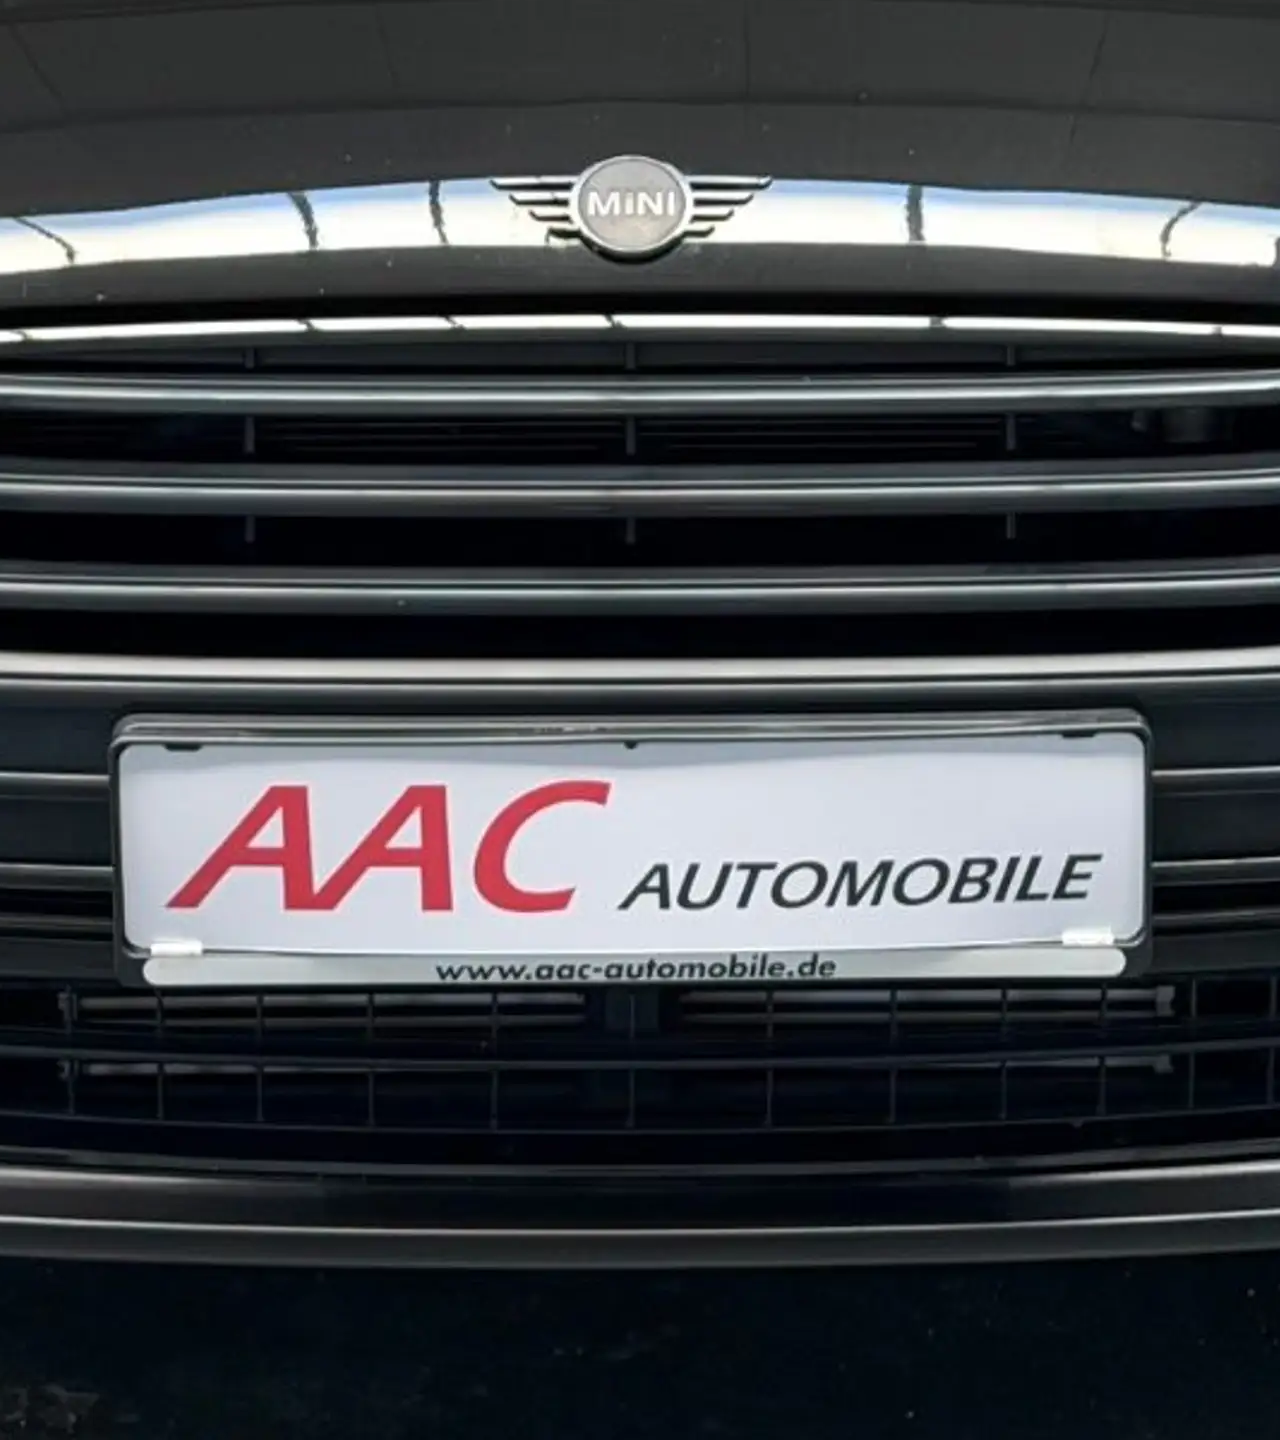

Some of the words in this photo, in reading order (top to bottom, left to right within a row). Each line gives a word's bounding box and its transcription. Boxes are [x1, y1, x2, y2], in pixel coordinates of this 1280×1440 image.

[587, 191, 676, 217] MINI
[166, 780, 611, 913] AAC
[618, 853, 1103, 911] AUTOMOBILE
[435, 953, 837, 982] www.aac-automobile.de
